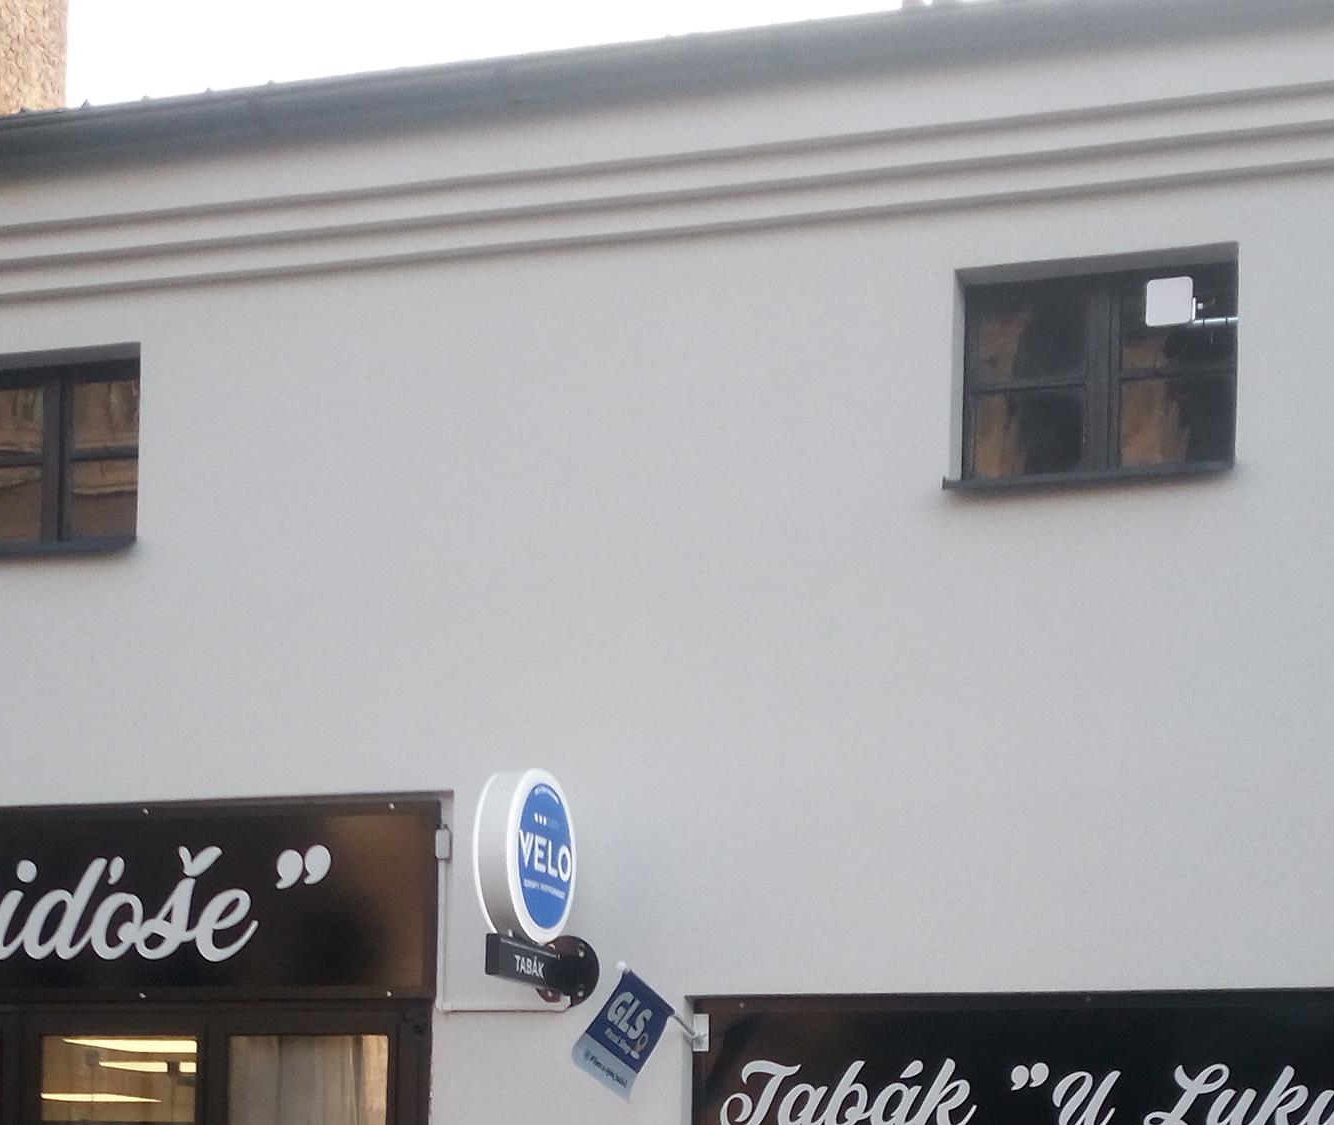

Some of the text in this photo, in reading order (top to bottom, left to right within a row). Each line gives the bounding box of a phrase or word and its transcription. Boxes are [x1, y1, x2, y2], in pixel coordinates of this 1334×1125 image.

[518, 829, 572, 883] VELO
[514, 954, 545, 980] TABÁK
[607, 991, 653, 1040] GLS
